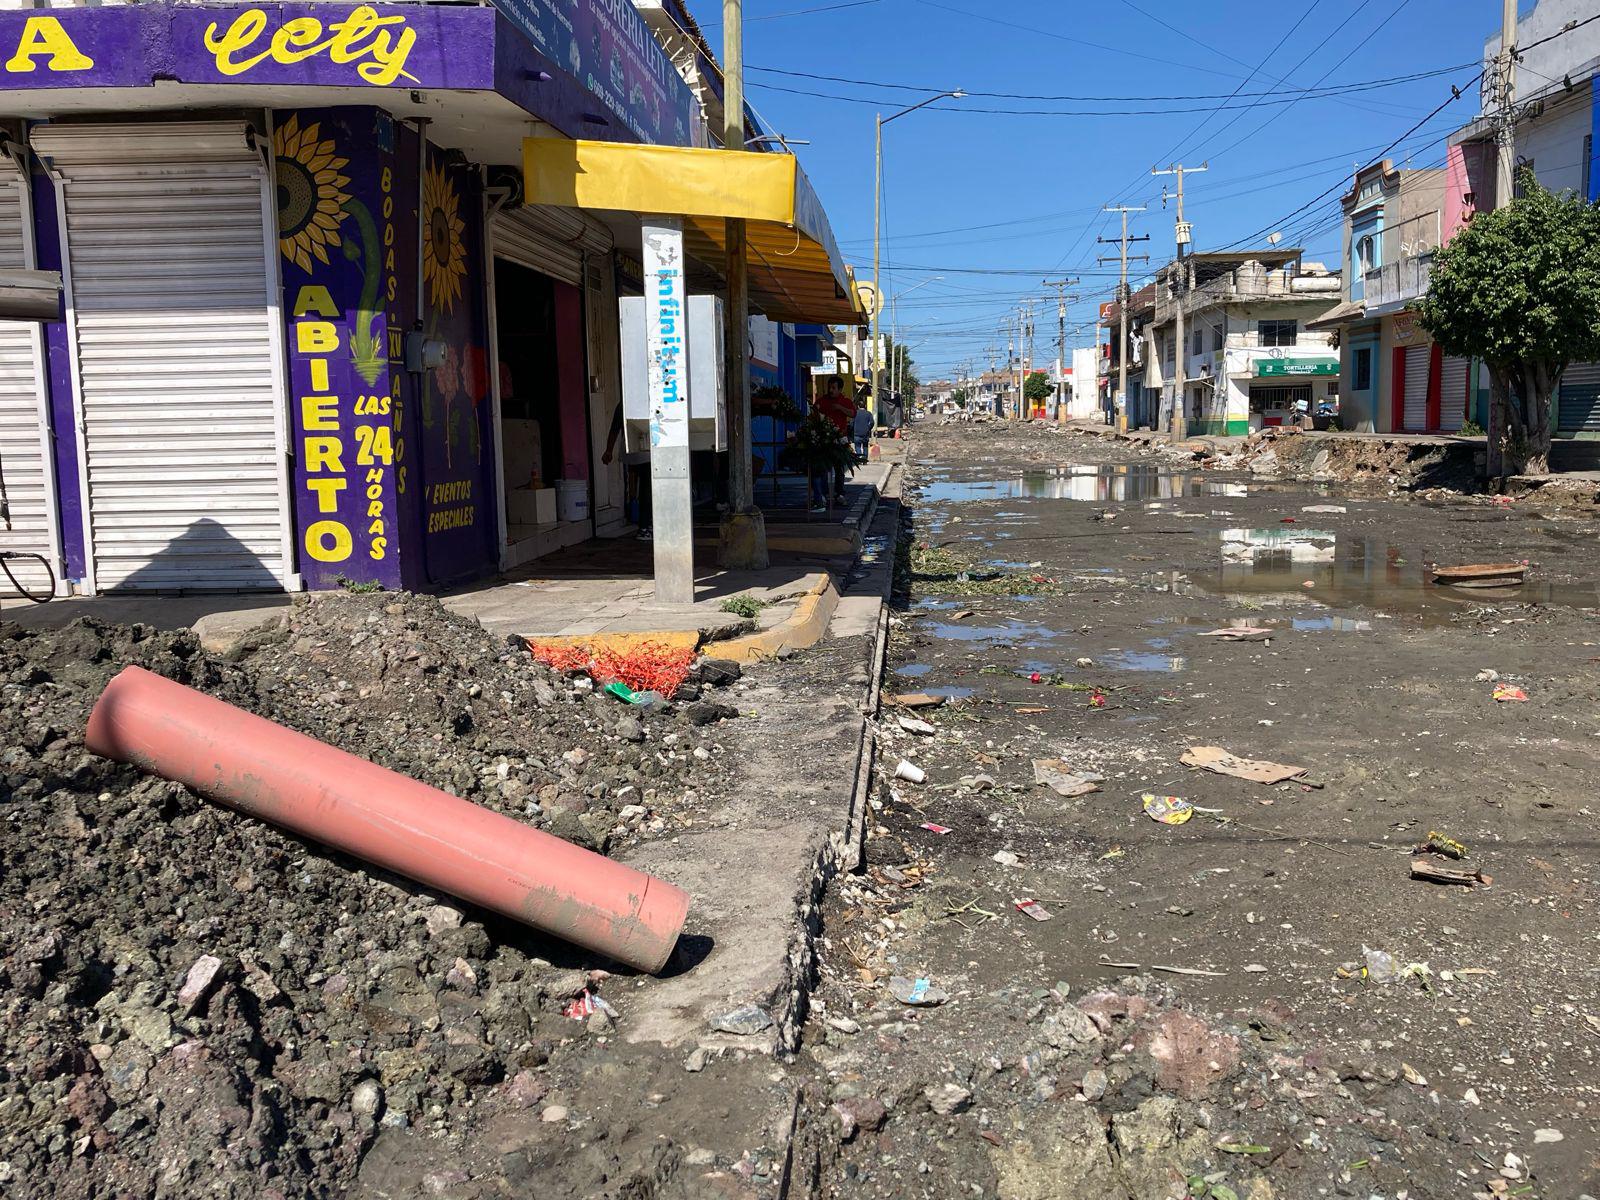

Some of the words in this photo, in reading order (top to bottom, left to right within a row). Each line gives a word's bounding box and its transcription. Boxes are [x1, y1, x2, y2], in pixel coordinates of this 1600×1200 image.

[5, 16, 94, 73] A
[645, 31, 666, 87] LETY
[381, 166, 397, 302] BODAS
[388, 329, 402, 361] XV
[293, 285, 353, 562] ABIERTO
[353, 395, 392, 416] LAS
[355, 425, 393, 466] 24
[393, 376, 407, 495] AÑOS
[364, 468, 387, 560] HORAS
[428, 505, 474, 534] ESPECIALES
[433, 480, 472, 505] EVENTOS
